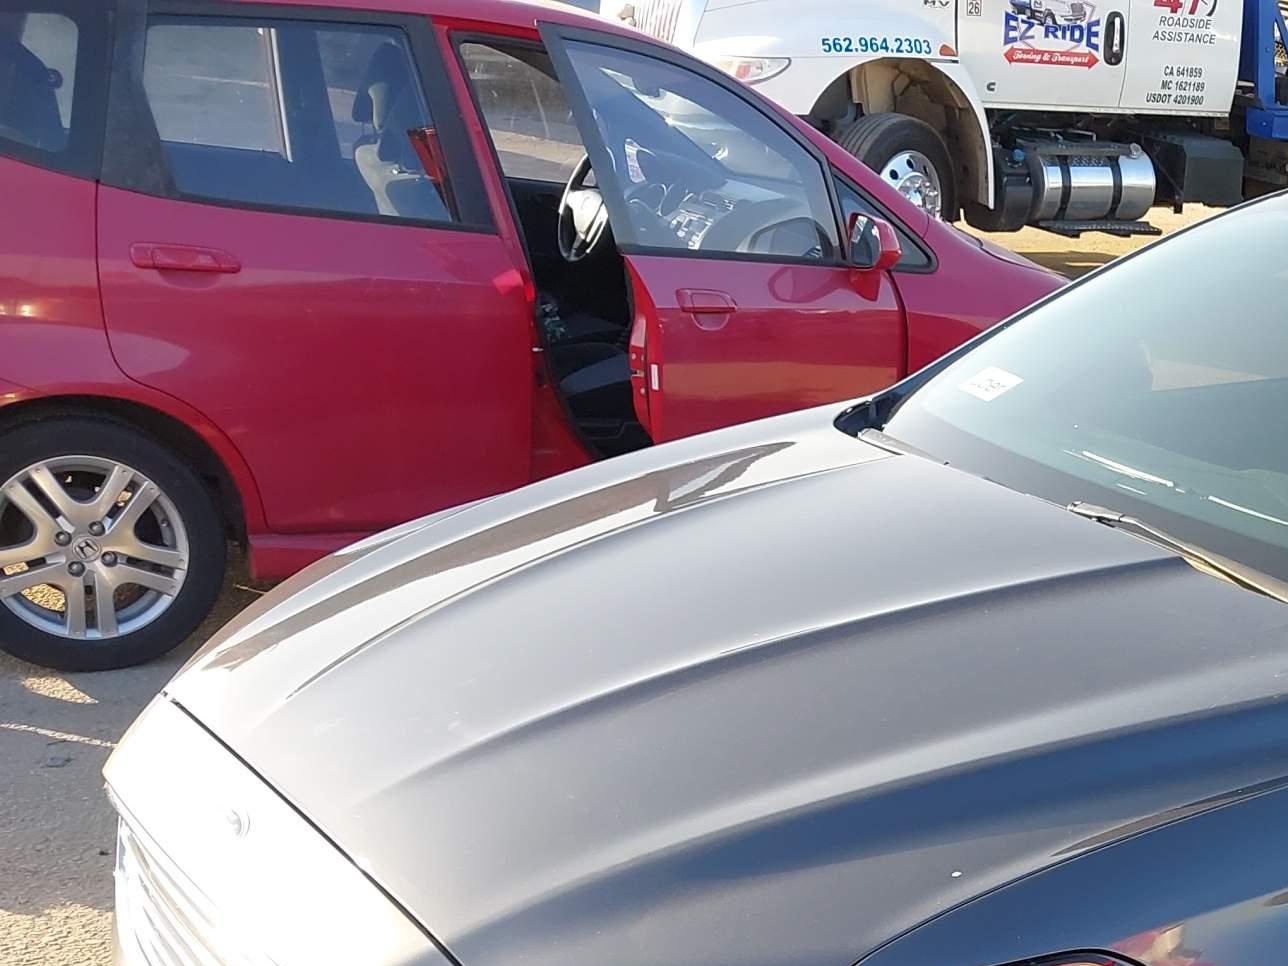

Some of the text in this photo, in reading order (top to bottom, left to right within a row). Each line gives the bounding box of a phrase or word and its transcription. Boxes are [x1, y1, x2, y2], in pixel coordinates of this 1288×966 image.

[968, 2, 980, 15] 26
[1159, 16, 1212, 29] ROADSIDE
[1004, 10, 1101, 52] EZ RIDE
[1152, 30, 1216, 44] ASSISTANCE
[821, 37, 932, 55] 562.964.2303
[1164, 65, 1203, 78] CA 641859
[1161, 80, 1205, 92] MC 1621189
[1146, 93, 1204, 105] USDOT 4201900
